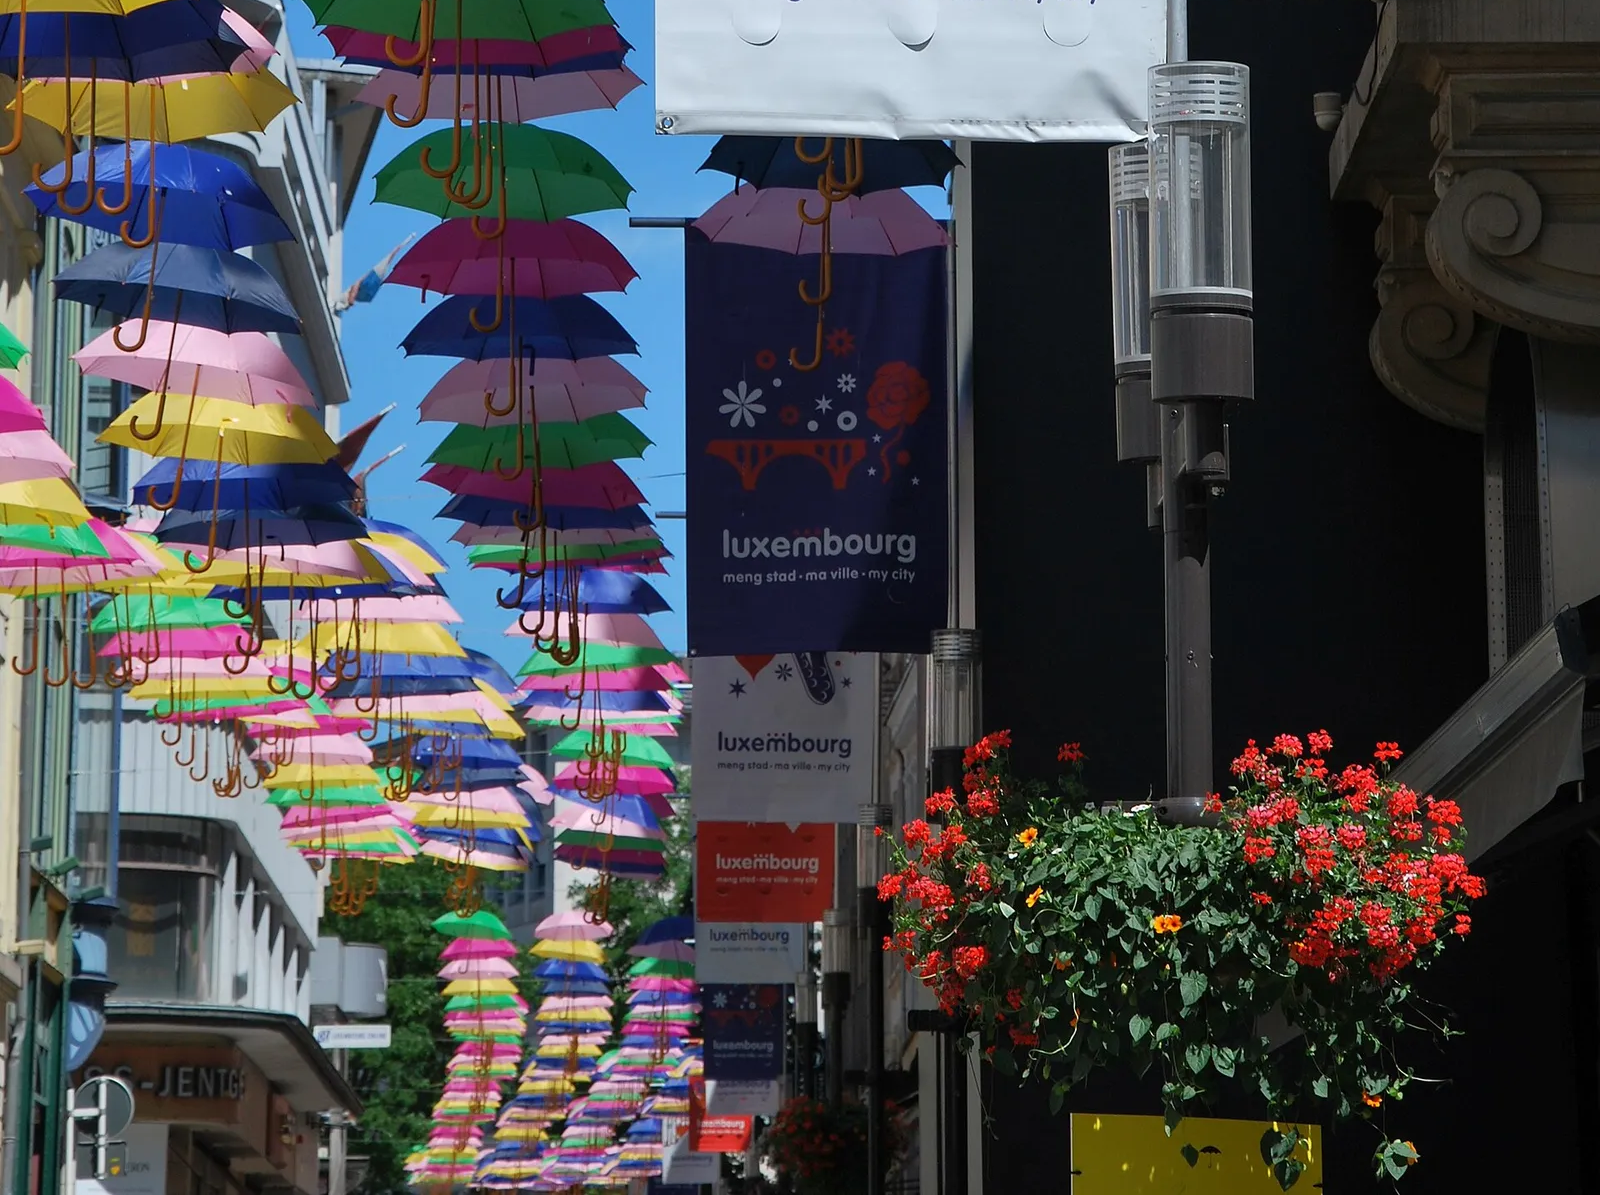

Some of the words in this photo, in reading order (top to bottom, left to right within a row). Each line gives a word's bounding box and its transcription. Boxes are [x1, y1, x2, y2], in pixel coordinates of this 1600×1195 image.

[722, 528, 916, 563] luxembourg
[723, 573, 763, 586] meng
[766, 569, 797, 583] stad
[805, 571, 827, 581] ma
[830, 566, 859, 580] ville
[868, 570, 889, 582] my
[892, 568, 916, 583] city
[717, 731, 852, 759] luxembourg
[717, 762, 745, 772] meng
[748, 761, 768, 770] stad
[792, 761, 811, 771] ville
[818, 763, 832, 772] my
[834, 762, 851, 773] city
[715, 853, 819, 874] luxembourg
[709, 928, 790, 945] luxembourg
